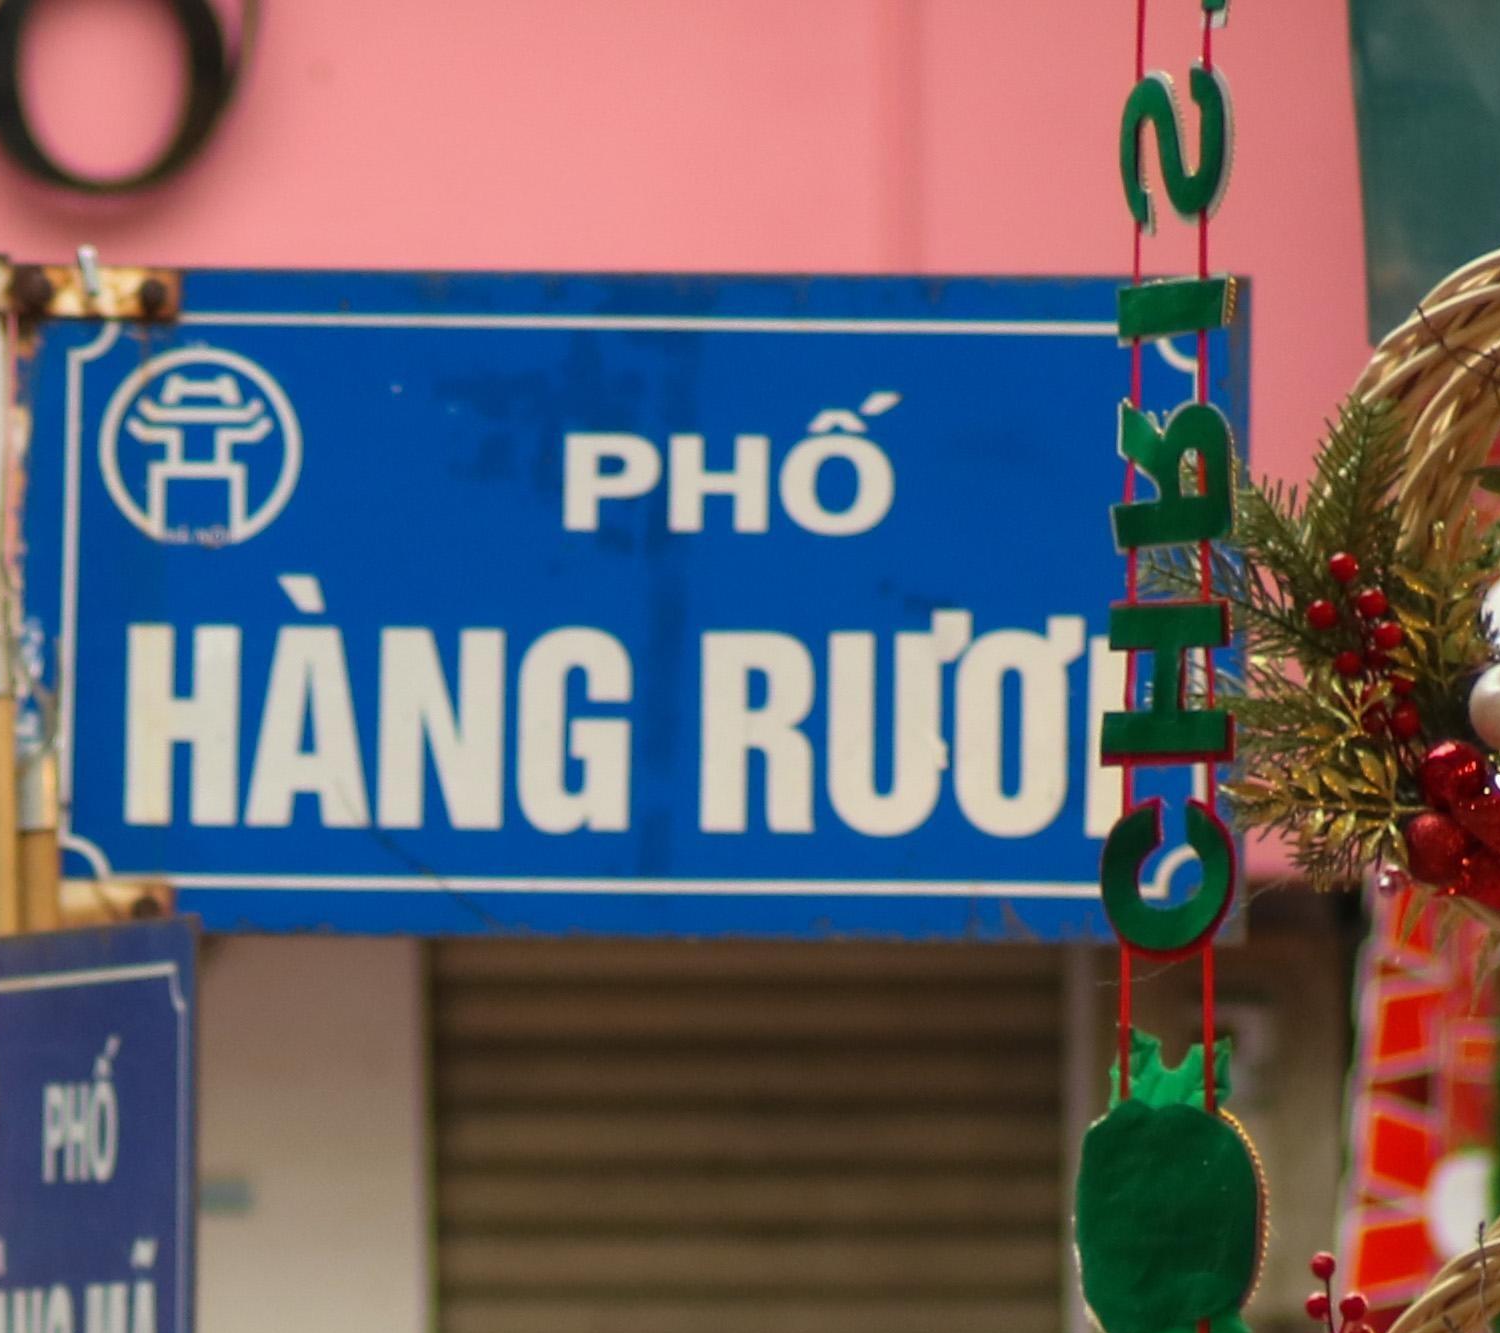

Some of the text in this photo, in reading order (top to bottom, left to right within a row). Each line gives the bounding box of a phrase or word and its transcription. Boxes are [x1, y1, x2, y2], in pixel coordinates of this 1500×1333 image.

[562, 391, 899, 536] PHỐ
[125, 573, 635, 835] HÀNG
[41, 1034, 119, 1185] PHỐ
